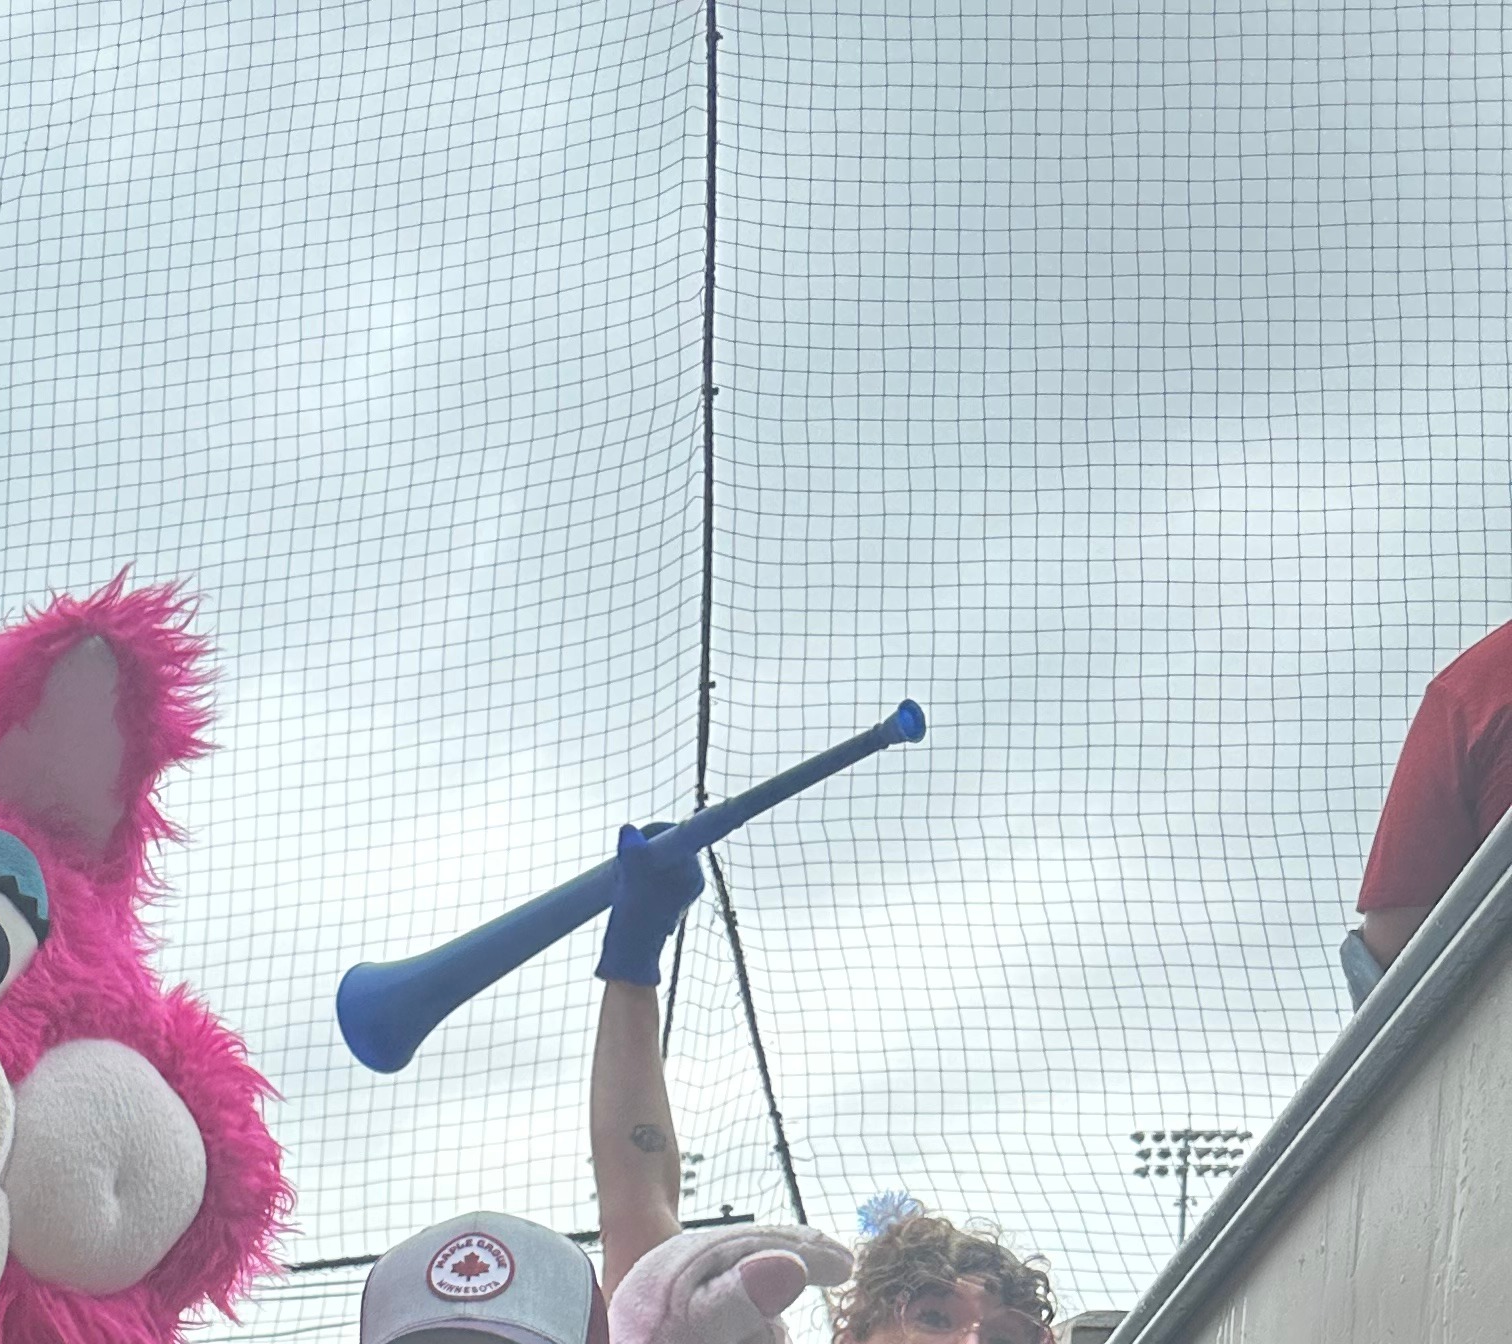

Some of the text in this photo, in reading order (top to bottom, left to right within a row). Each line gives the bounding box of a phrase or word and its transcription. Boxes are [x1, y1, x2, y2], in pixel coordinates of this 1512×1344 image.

[435, 1239, 508, 1269] MAPLE GROVE
[437, 1280, 500, 1294] MINNESOTA
